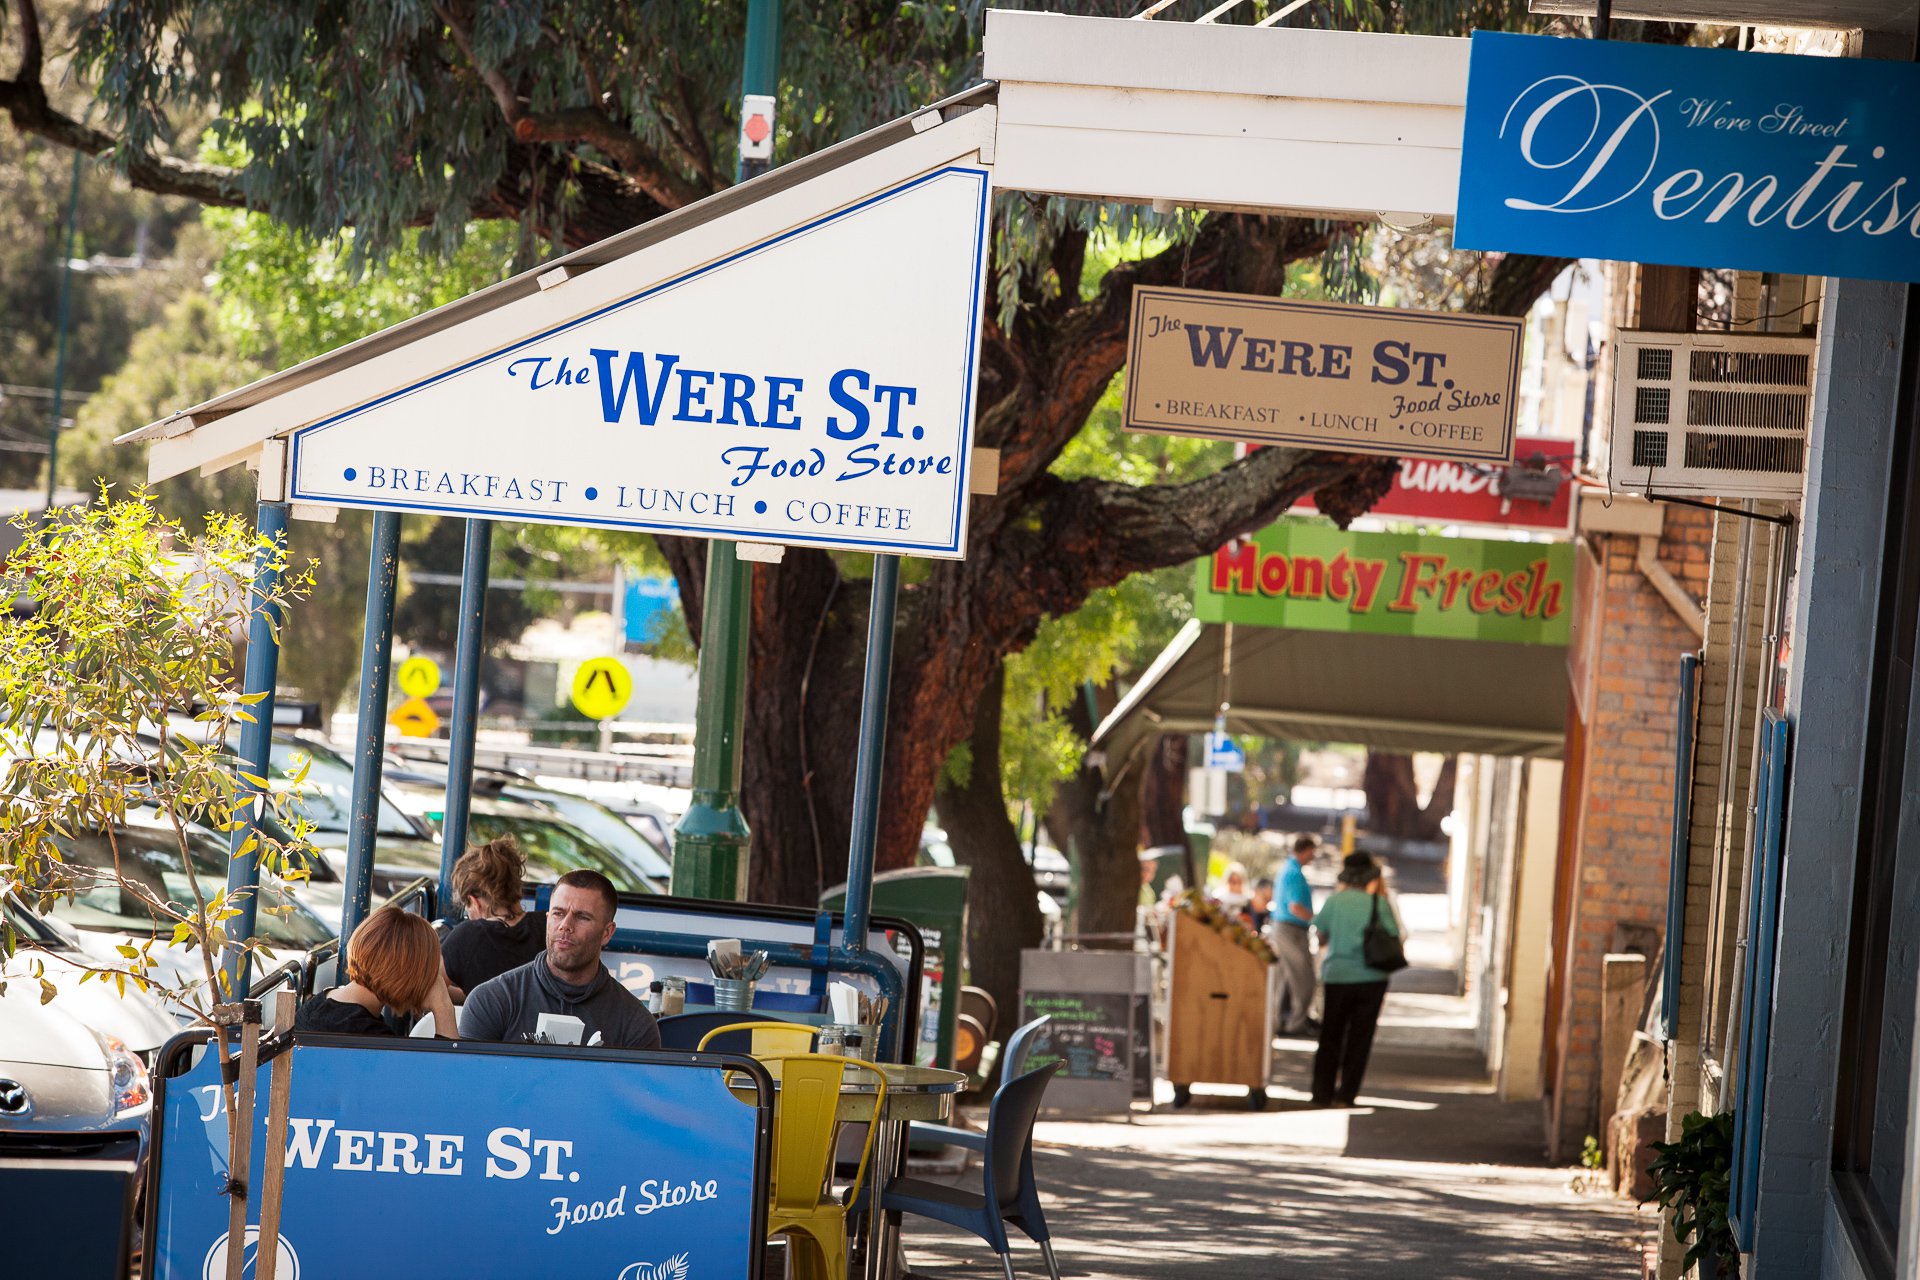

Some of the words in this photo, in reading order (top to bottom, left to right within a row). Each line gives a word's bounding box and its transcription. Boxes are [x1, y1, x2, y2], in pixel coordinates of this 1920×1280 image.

[1678, 97, 1752, 132] Were
[1758, 103, 1850, 139] Street
[1499, 75, 1920, 239] Dentis
[1147, 315, 1182, 338] The
[1183, 323, 1353, 380] WERE
[507, 356, 592, 392] The
[590, 348, 803, 431] WERE
[1389, 392, 1441, 420] Food
[1446, 389, 1502, 413] Store
[1166, 399, 1281, 424] BREAKFAST
[1310, 412, 1379, 433] LUNCH
[1409, 421, 1485, 442] COFFEE
[720, 444, 827, 488] Food
[835, 442, 953, 483] Store
[367, 464, 569, 504] BREAKFAST
[615, 485, 736, 518] LUNCH
[784, 500, 913, 531] COFFEE
[1210, 541, 1387, 614] Monty
[1388, 551, 1565, 620] Fresh
[264, 1116, 465, 1177] WERE
[545, 1184, 628, 1236] Food
[634, 1178, 719, 1216] Store
